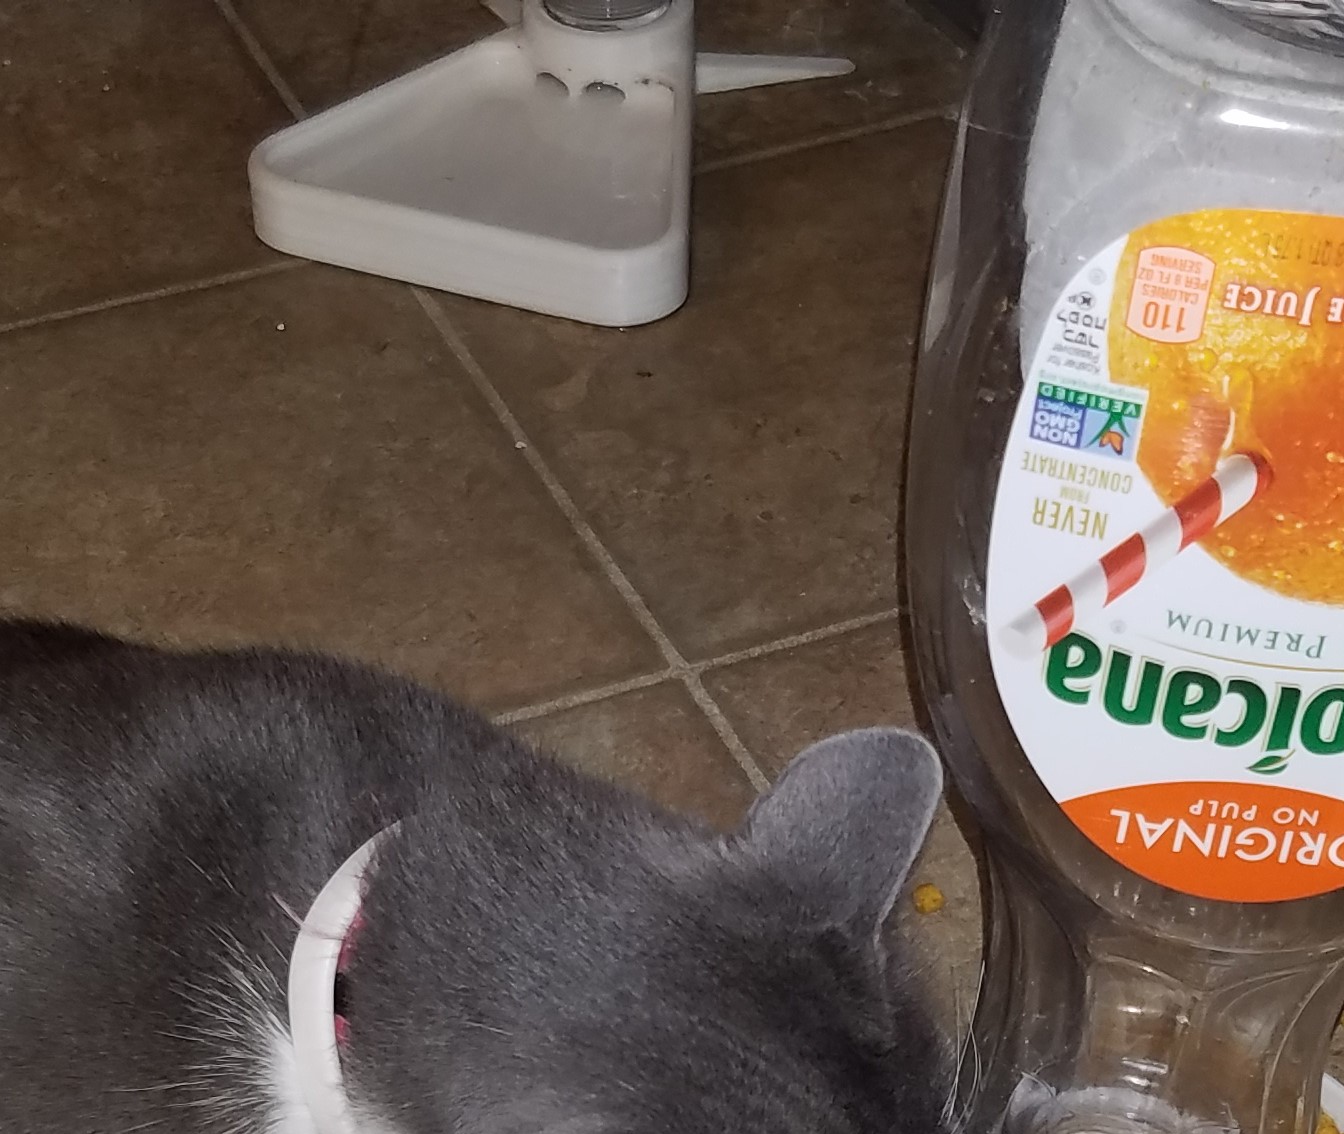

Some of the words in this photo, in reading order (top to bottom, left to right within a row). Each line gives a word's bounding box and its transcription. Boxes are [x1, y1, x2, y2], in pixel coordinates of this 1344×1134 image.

[1138, 267, 1154, 281] OZ
[1151, 254, 1202, 274] SERVING
[1159, 271, 1172, 285] FL
[1174, 274, 1182, 285] 8
[1184, 276, 1209, 292] PER
[1142, 283, 1200, 305] CALORIES
[1223, 283, 1321, 327] JUICE
[1142, 301, 1186, 333] 110
[1040, 385, 1137, 416] VERIFIED
[1035, 411, 1081, 432] GMO
[1033, 424, 1079, 447] NON
[1021, 451, 1133, 494] CONCENTRATE
[1060, 486, 1090, 504] FROM
[1032, 497, 1109, 540] NEVER
[1166, 609, 1325, 659] PREMIUM
[1188, 799, 1257, 821] PULP
[1272, 808, 1320, 827] NO
